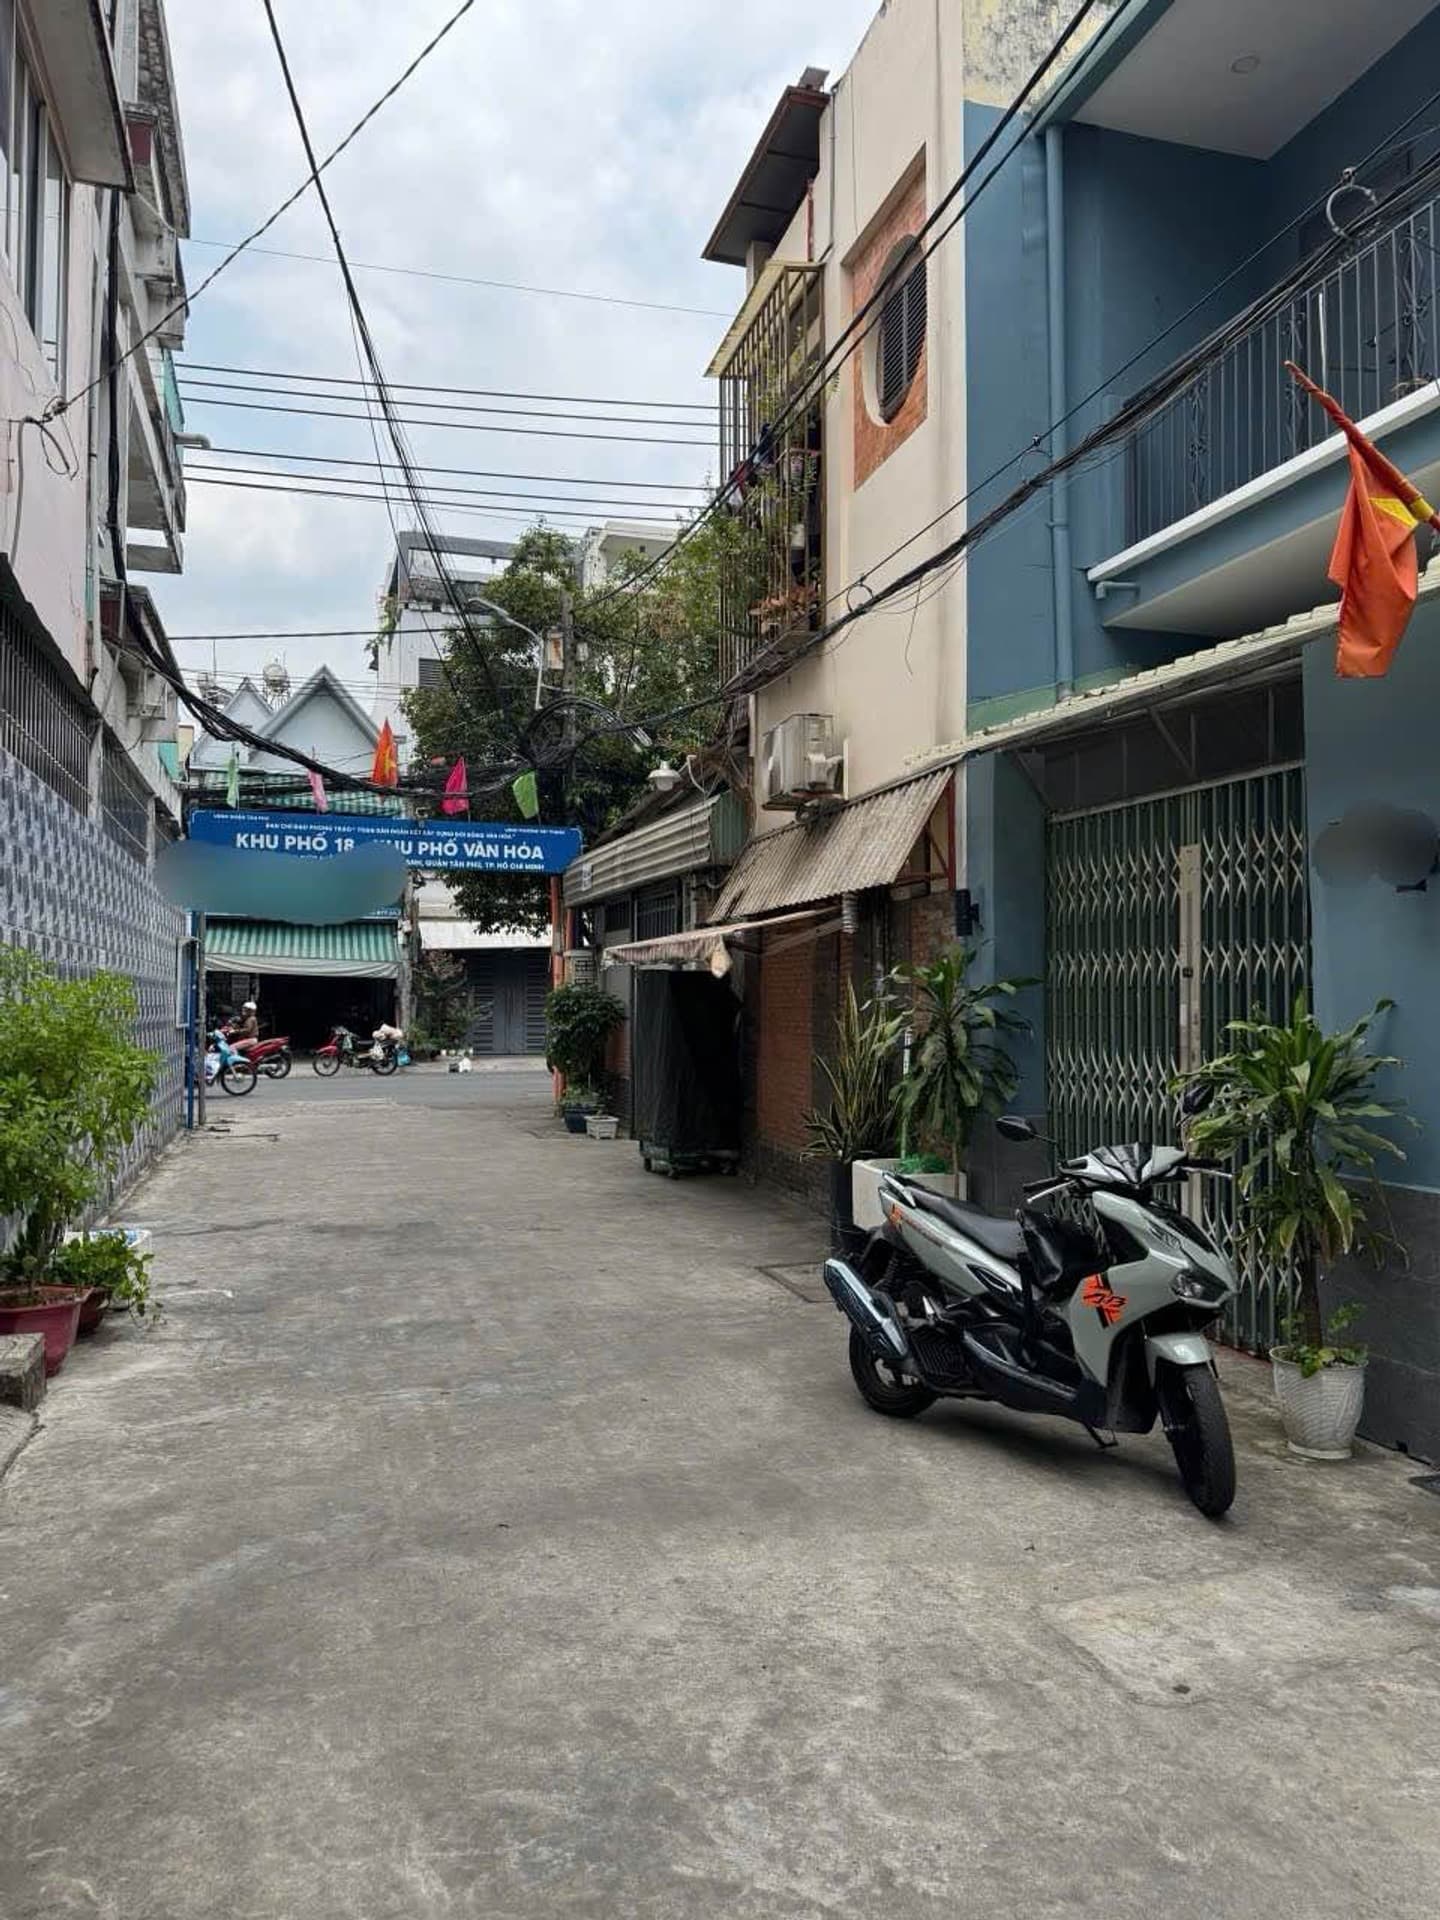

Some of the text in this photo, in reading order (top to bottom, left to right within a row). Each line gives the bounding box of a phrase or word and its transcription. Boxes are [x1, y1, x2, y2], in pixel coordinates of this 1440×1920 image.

[235, 833, 279, 849] KHU
[285, 830, 328, 851] PHỐ
[334, 838, 355, 852] 18
[418, 837, 458, 857] PHỐ
[463, 840, 499, 858] VĂN
[504, 842, 545, 860] HÓA
